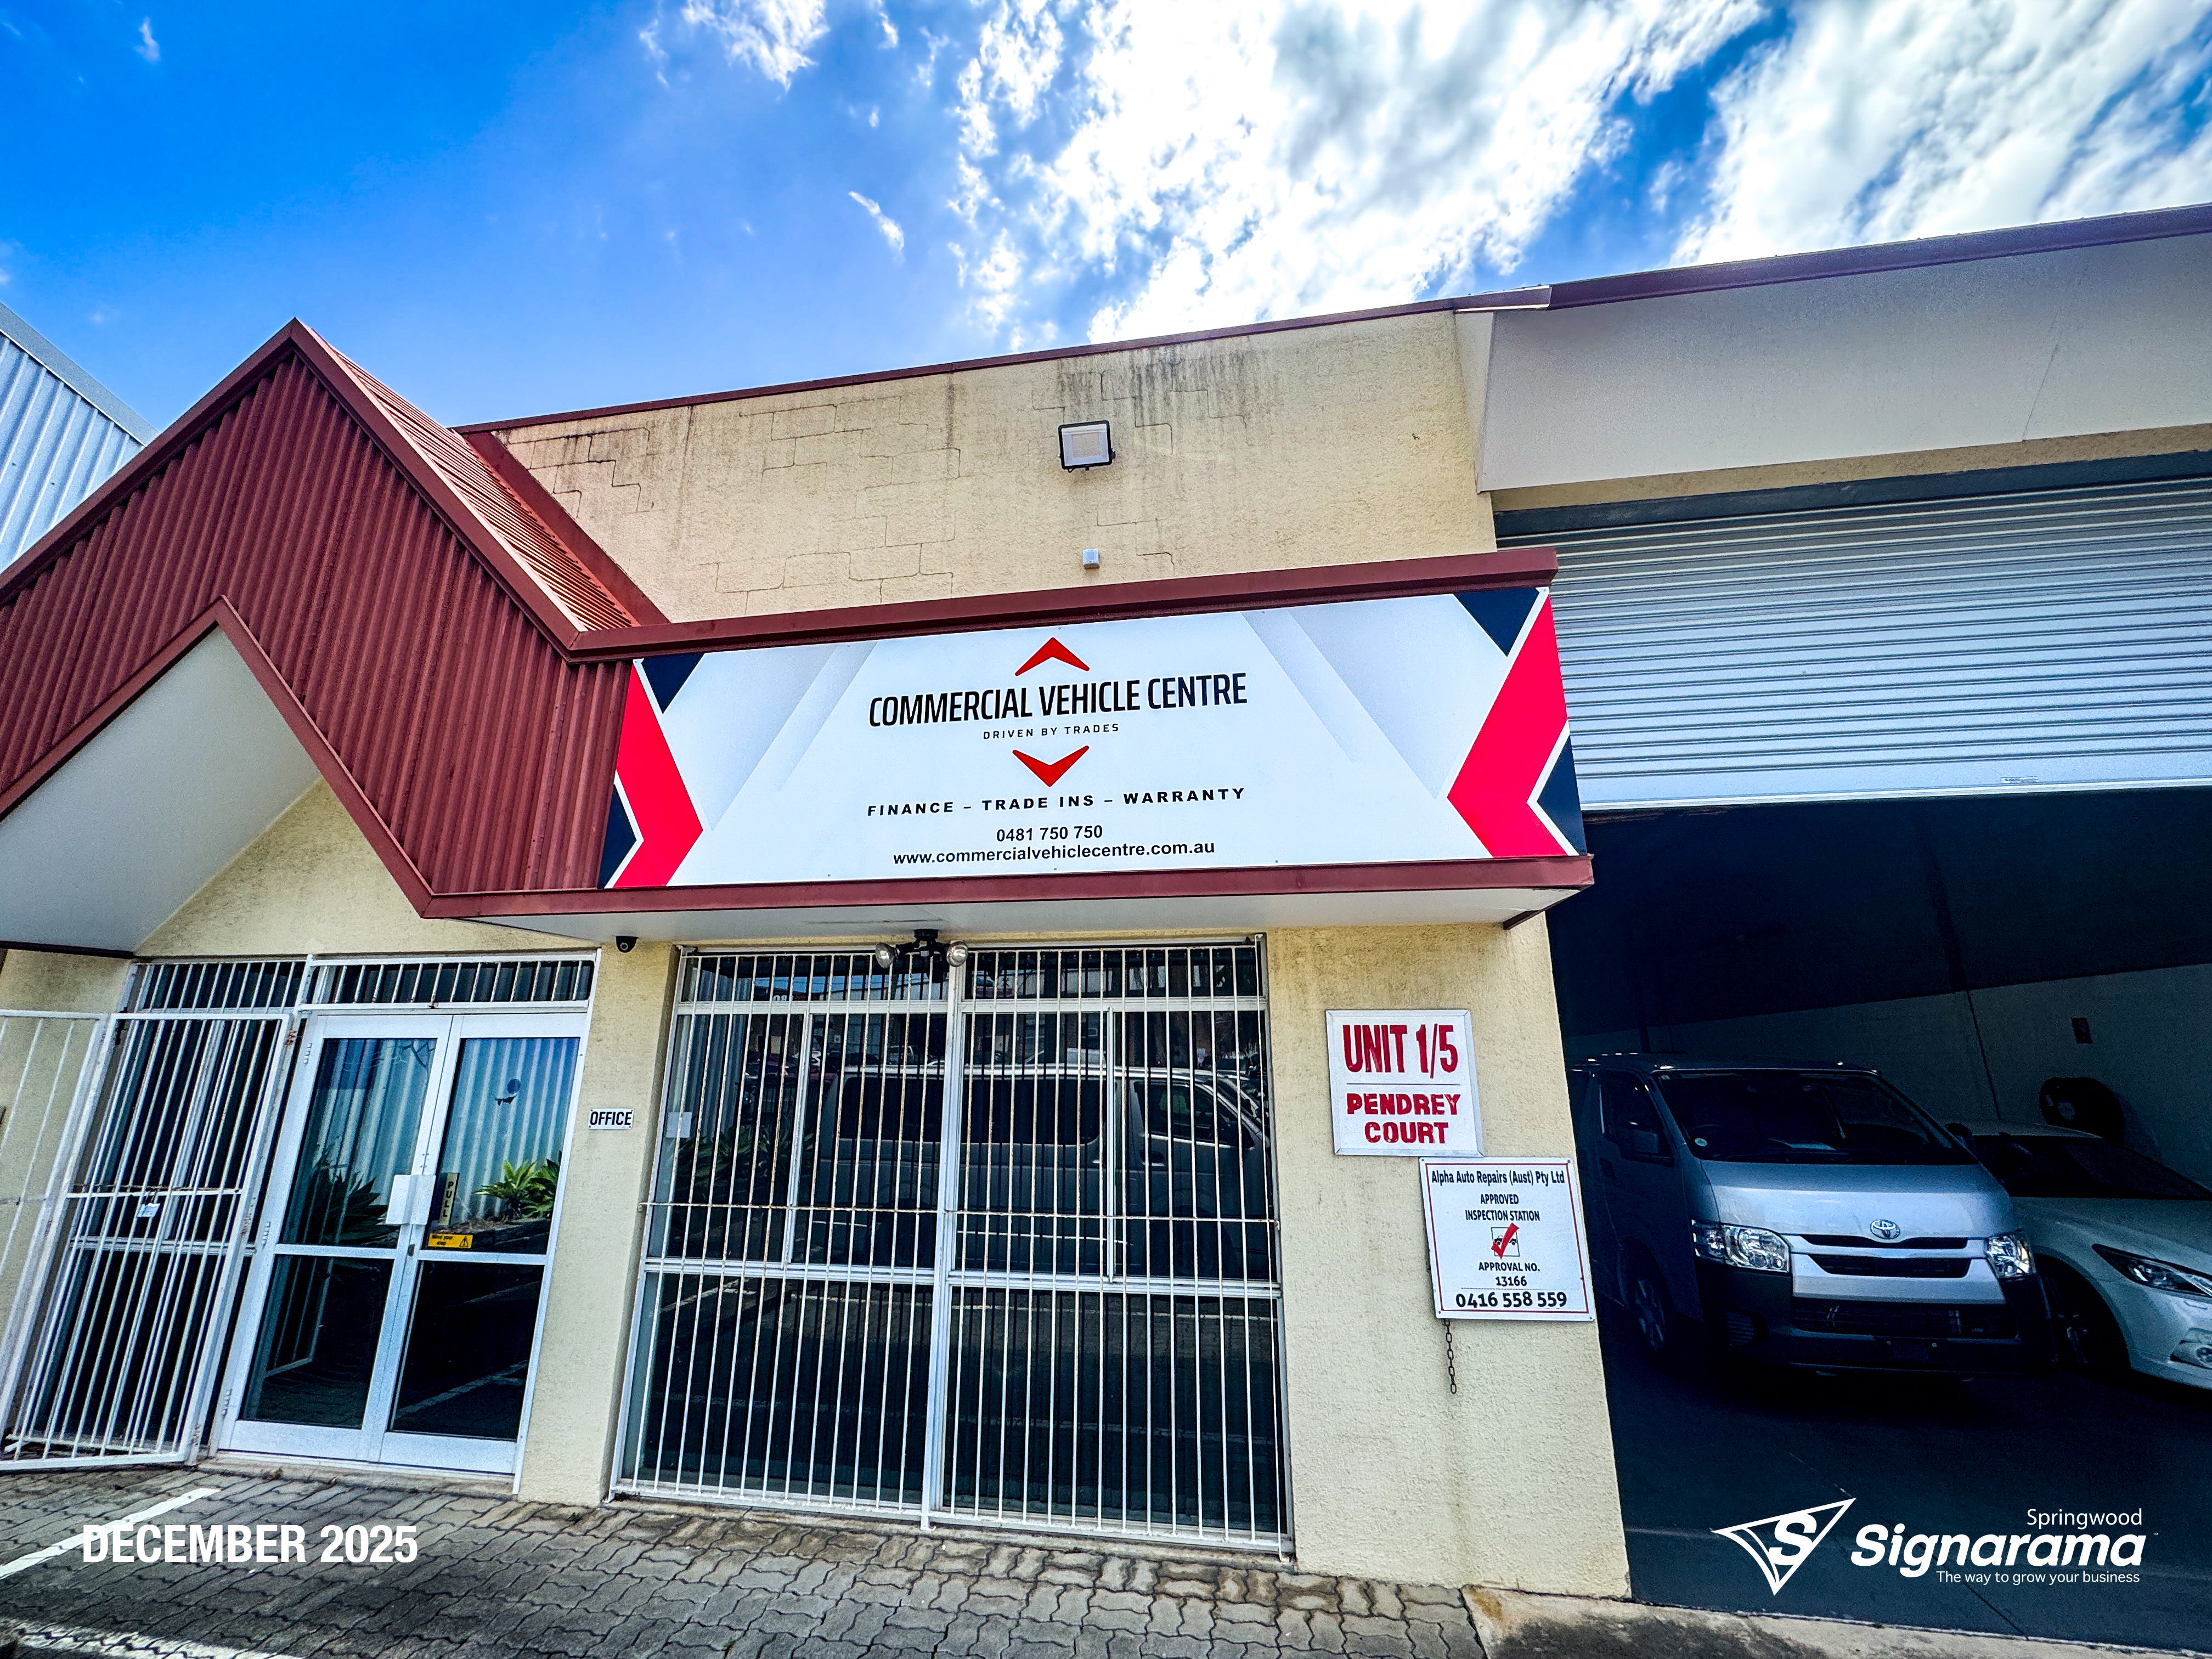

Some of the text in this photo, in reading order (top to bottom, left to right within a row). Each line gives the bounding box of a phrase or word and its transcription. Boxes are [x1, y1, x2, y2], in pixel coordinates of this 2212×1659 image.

[869, 673, 1248, 727] COMMERCIAL VEHICLE CENTRE
[983, 723, 1119, 740] DRIVEN BY TRADES
[867, 802, 953, 816] FINANCE
[981, 797, 1048, 811] TRADE
[1059, 795, 1093, 808] INS
[1123, 788, 1244, 804] WARRANTY
[996, 825, 1103, 842] 0481 750 750
[893, 841, 1215, 864] www.commercialvehiclecentre.com.au
[1342, 1023, 1458, 1079] UNIT 1/5
[1347, 1093, 1461, 1115] PENDREY
[590, 1111, 633, 1125] OFFICE
[1364, 1122, 1449, 1143] COURT
[1431, 1170, 1565, 1187] Alpha Auto Repairs (Aust) Pty Ltd
[442, 1181, 454, 1217] PULL
[1480, 1194, 1519, 1205] APPROVED
[1465, 1210, 1541, 1221] INSPECTION STATION
[1479, 1262, 1541, 1272] APPROVAL NO.
[1495, 1276, 1527, 1286] 13166
[1455, 1291, 1567, 1307] 0416 558 559
